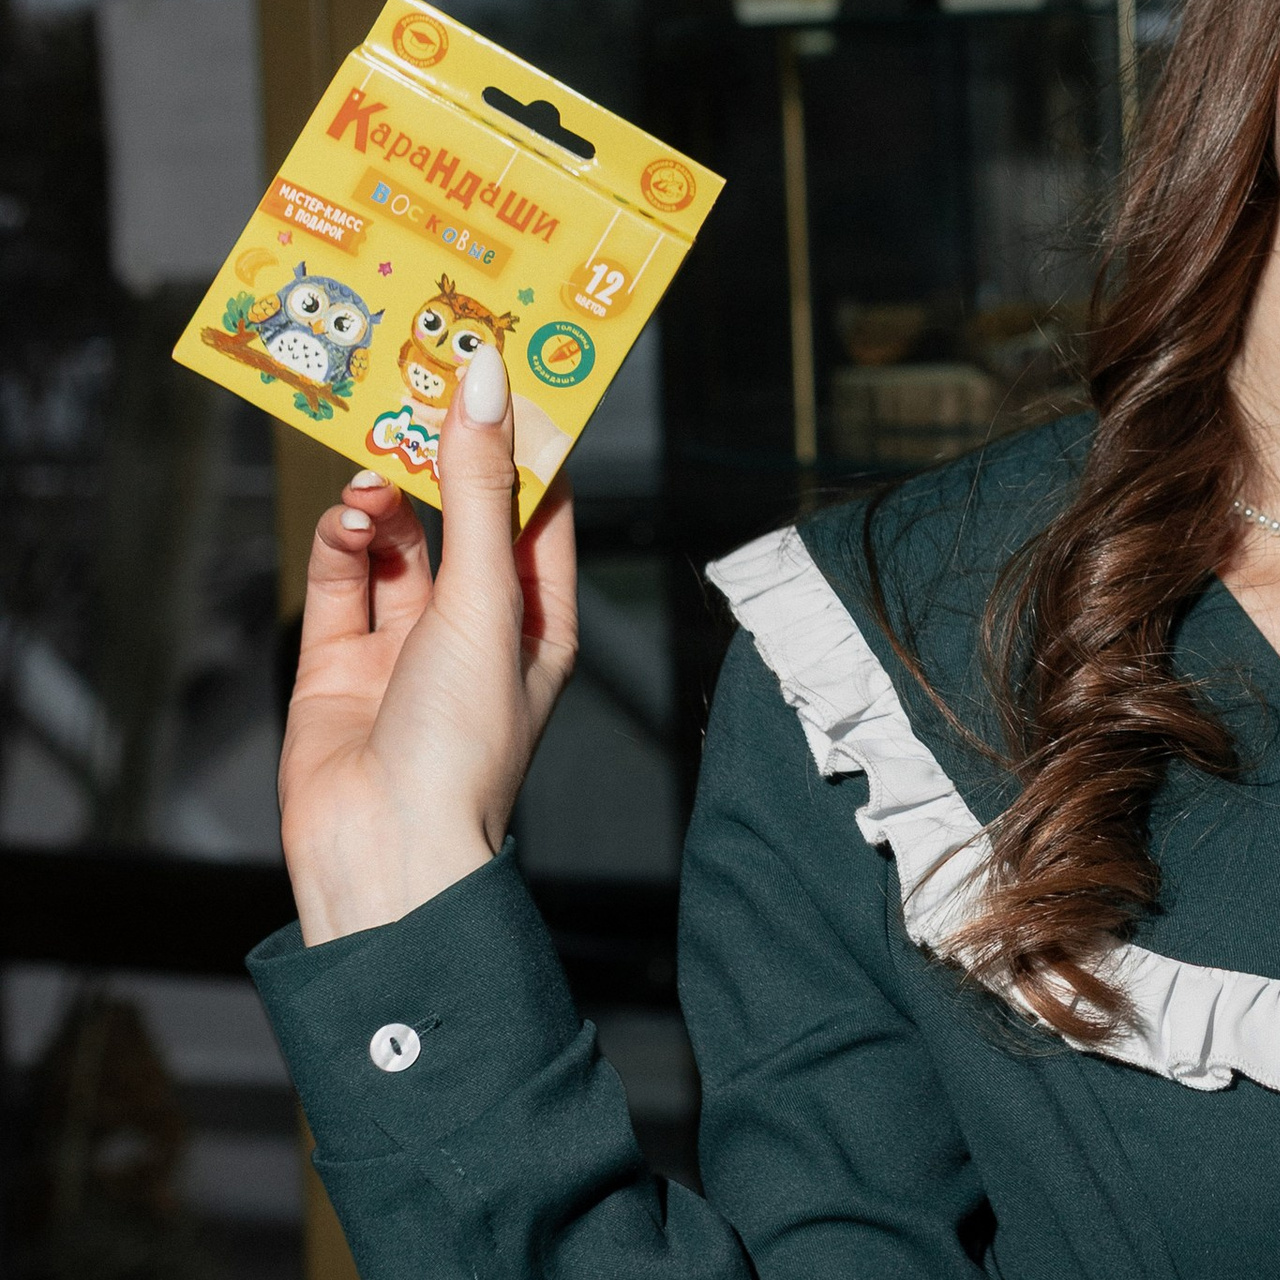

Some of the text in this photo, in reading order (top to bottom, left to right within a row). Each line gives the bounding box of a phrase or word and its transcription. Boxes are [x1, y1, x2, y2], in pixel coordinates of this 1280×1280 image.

[279, 183, 364, 233] МАСТЕР-КЛАСС
[284, 204, 345, 242] В ПОДАРОК
[371, 181, 496, 265] восковые
[574, 293, 607, 318] ЦВЕТОВ
[585, 263, 624, 306] 12
